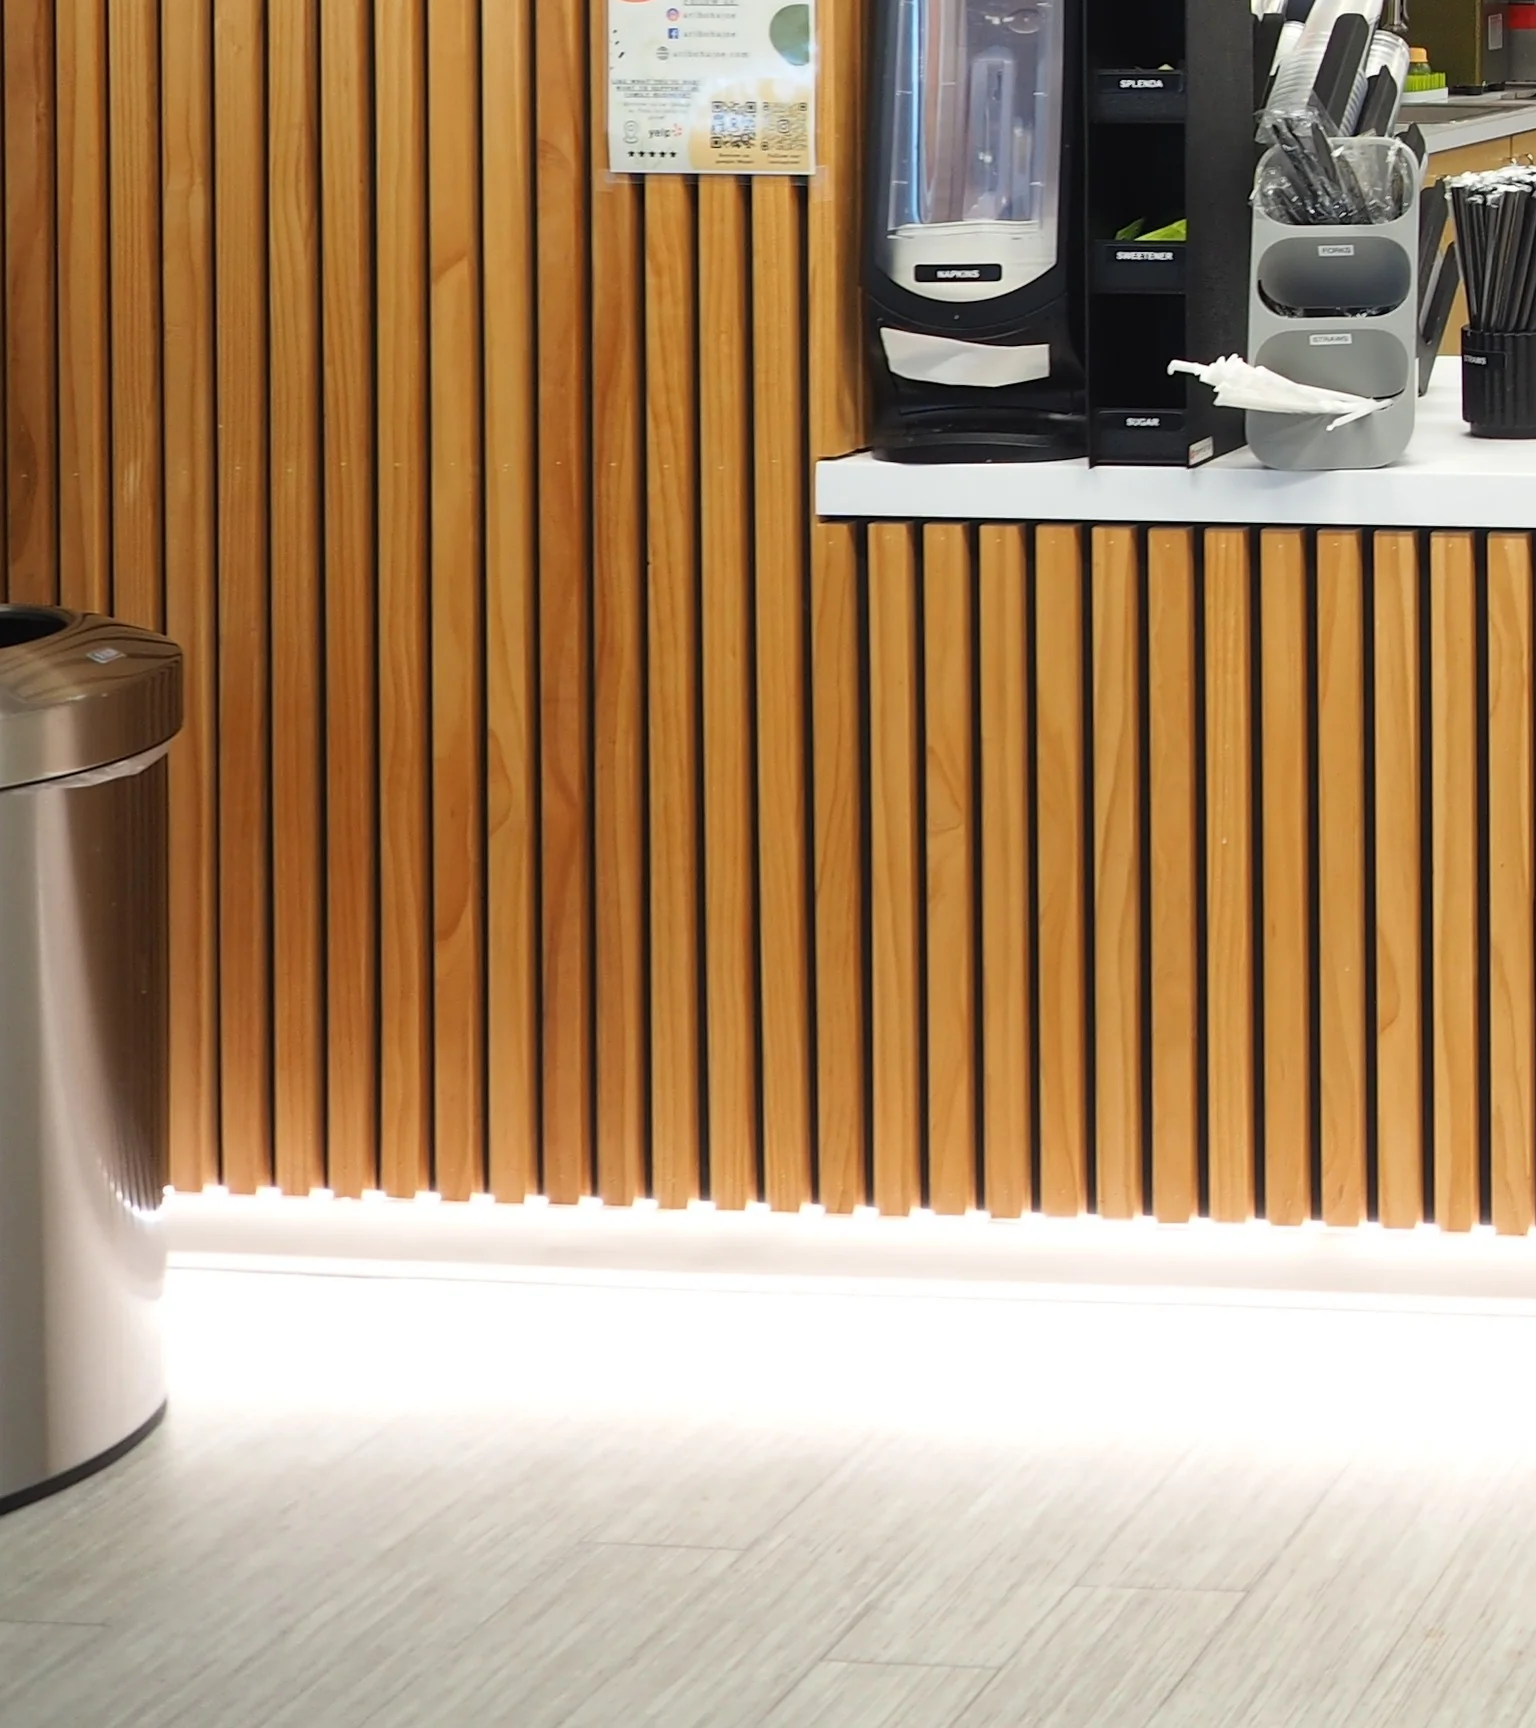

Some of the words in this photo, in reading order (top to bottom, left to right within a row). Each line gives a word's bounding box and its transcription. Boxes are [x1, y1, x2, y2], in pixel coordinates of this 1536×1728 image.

[1119, 79, 1164, 88] SPLENDA
[1116, 251, 1174, 260] SWEETENER
[936, 270, 980, 279] NAPKINS
[1126, 417, 1160, 426] SUGAR
